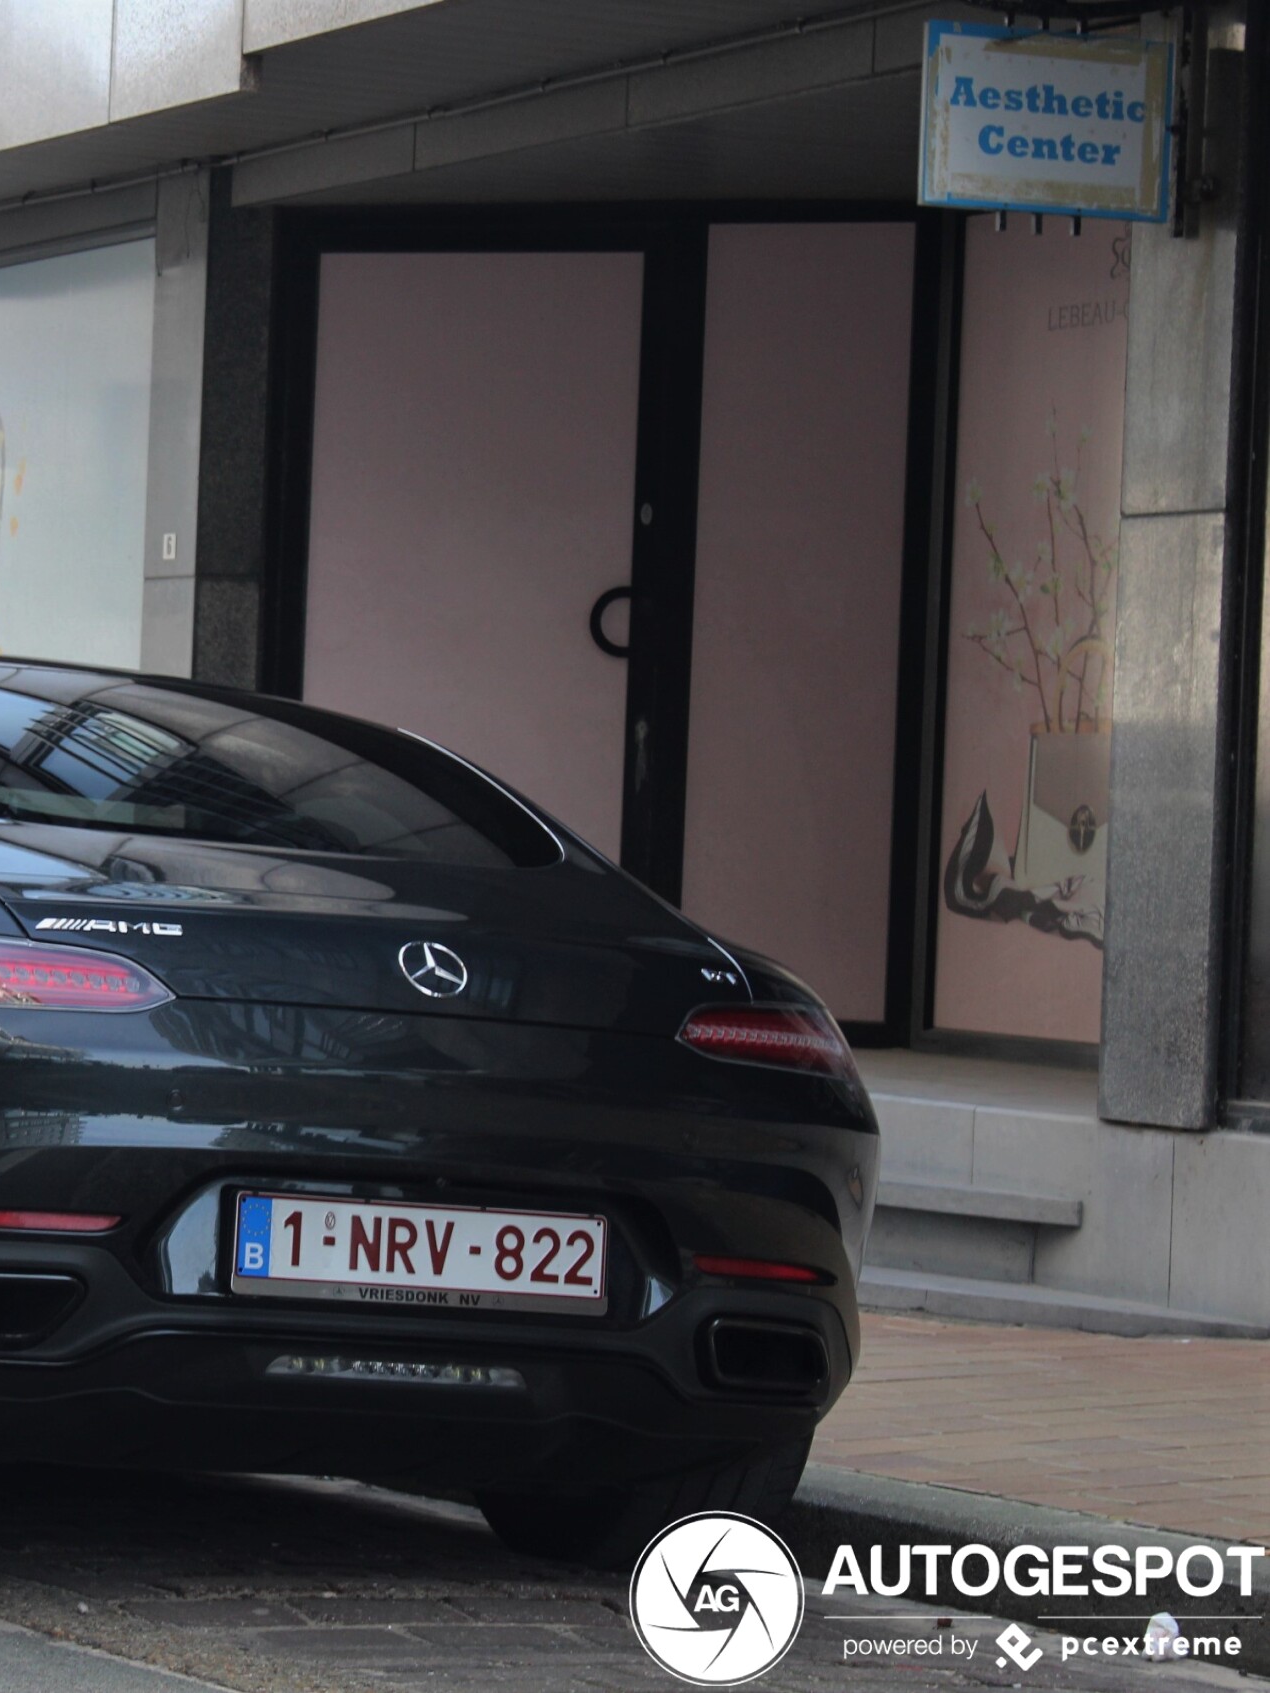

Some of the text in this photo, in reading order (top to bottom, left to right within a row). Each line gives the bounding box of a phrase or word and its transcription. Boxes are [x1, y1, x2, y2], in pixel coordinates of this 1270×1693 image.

[950, 76, 1146, 123] Aesthetic
[978, 124, 1121, 166] Center
[83, 918, 183, 936] AMG
[244, 1242, 264, 1269] B
[283, 1210, 596, 1286] 1-NRV-822
[358, 1286, 481, 1308] VRIESDONK NV
